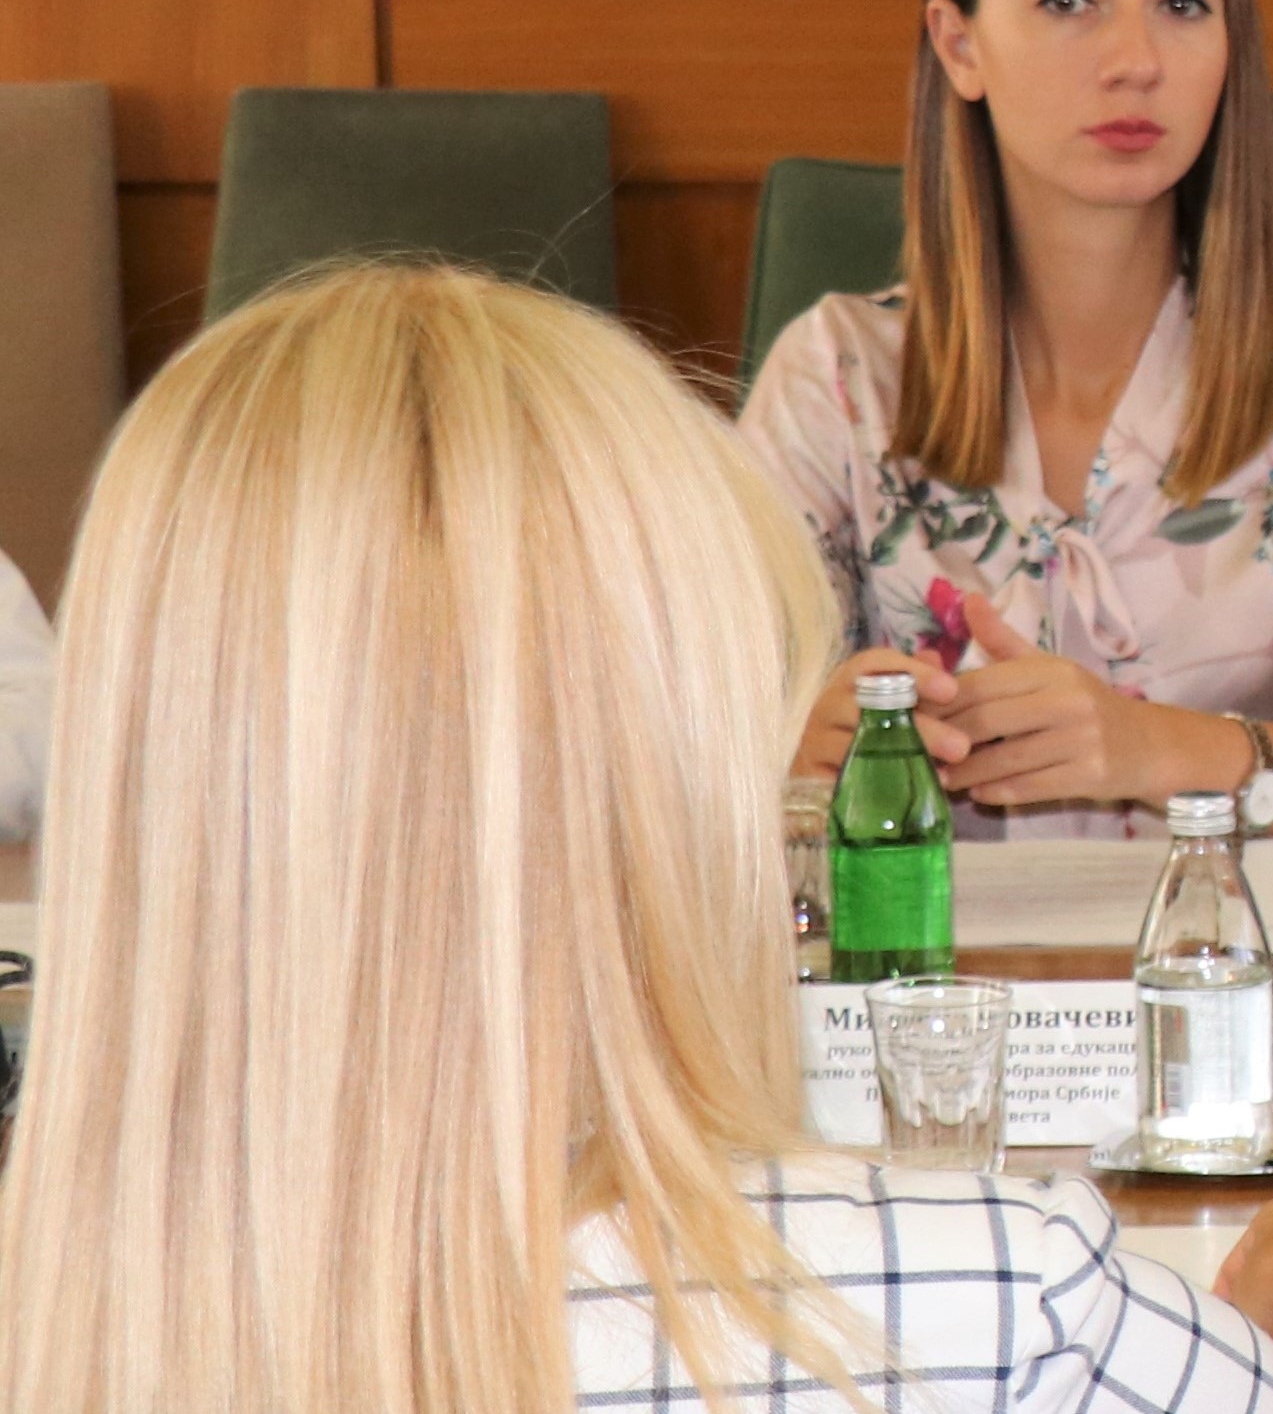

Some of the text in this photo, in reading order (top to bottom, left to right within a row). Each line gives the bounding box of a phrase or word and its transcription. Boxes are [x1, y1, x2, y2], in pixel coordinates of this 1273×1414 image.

[824, 1007, 1136, 1031] Ми овачеви
[828, 1046, 873, 1060] руко
[1008, 1044, 1031, 1058] ра
[1056, 1085, 1121, 1104] Србије
[1008, 1110, 1051, 1124] вета
